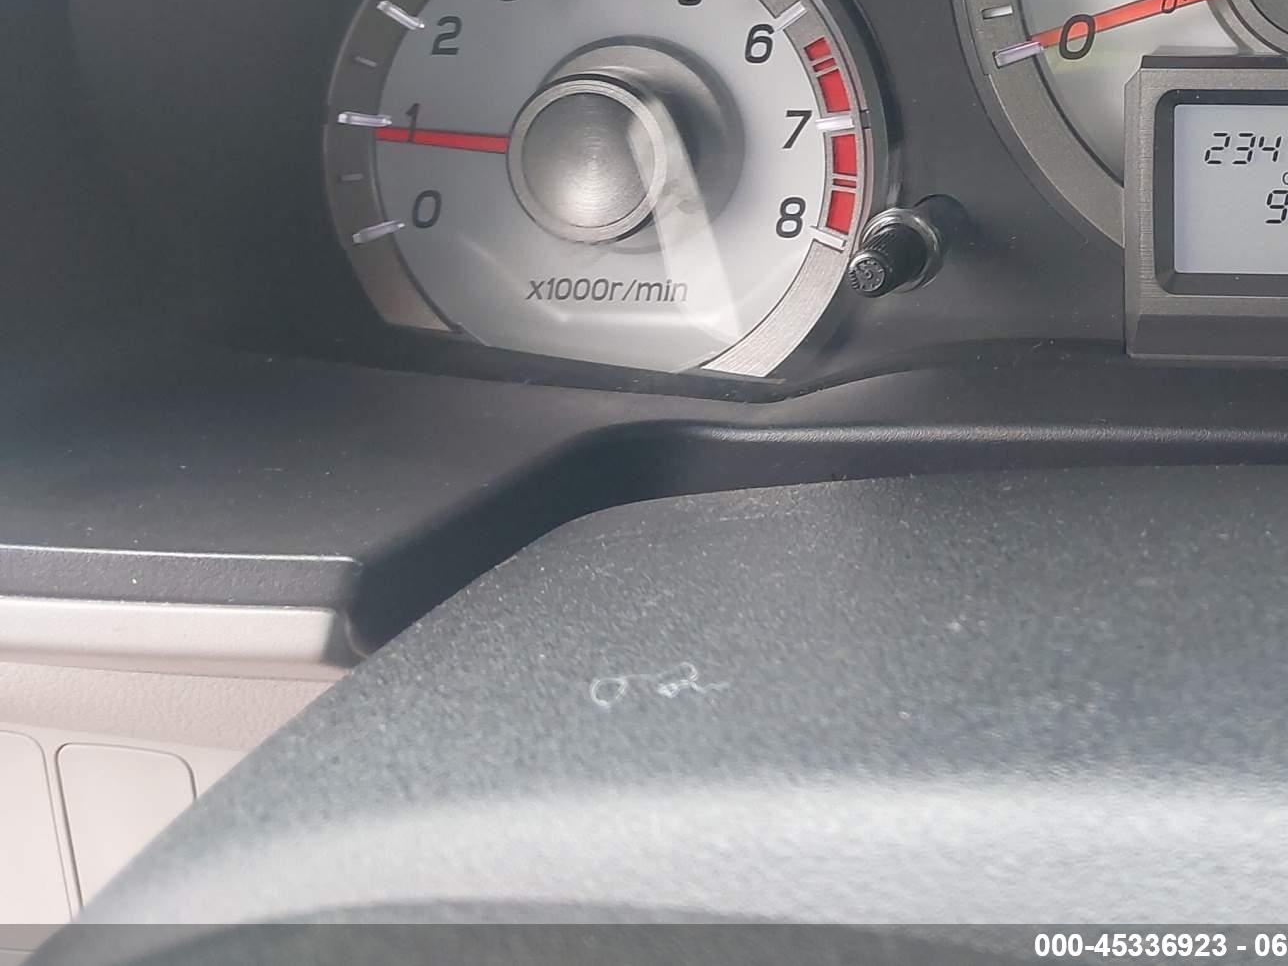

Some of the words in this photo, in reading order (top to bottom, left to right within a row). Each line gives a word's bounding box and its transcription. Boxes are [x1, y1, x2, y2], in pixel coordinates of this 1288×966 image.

[432, 15, 461, 56] 2
[745, 24, 773, 63] 6
[1059, 15, 1095, 59] 0
[406, 103, 420, 144] 1
[783, 110, 812, 149] 7
[412, 190, 441, 229] 0
[776, 197, 805, 238] 8
[527, 277, 687, 303] x1000r/min
